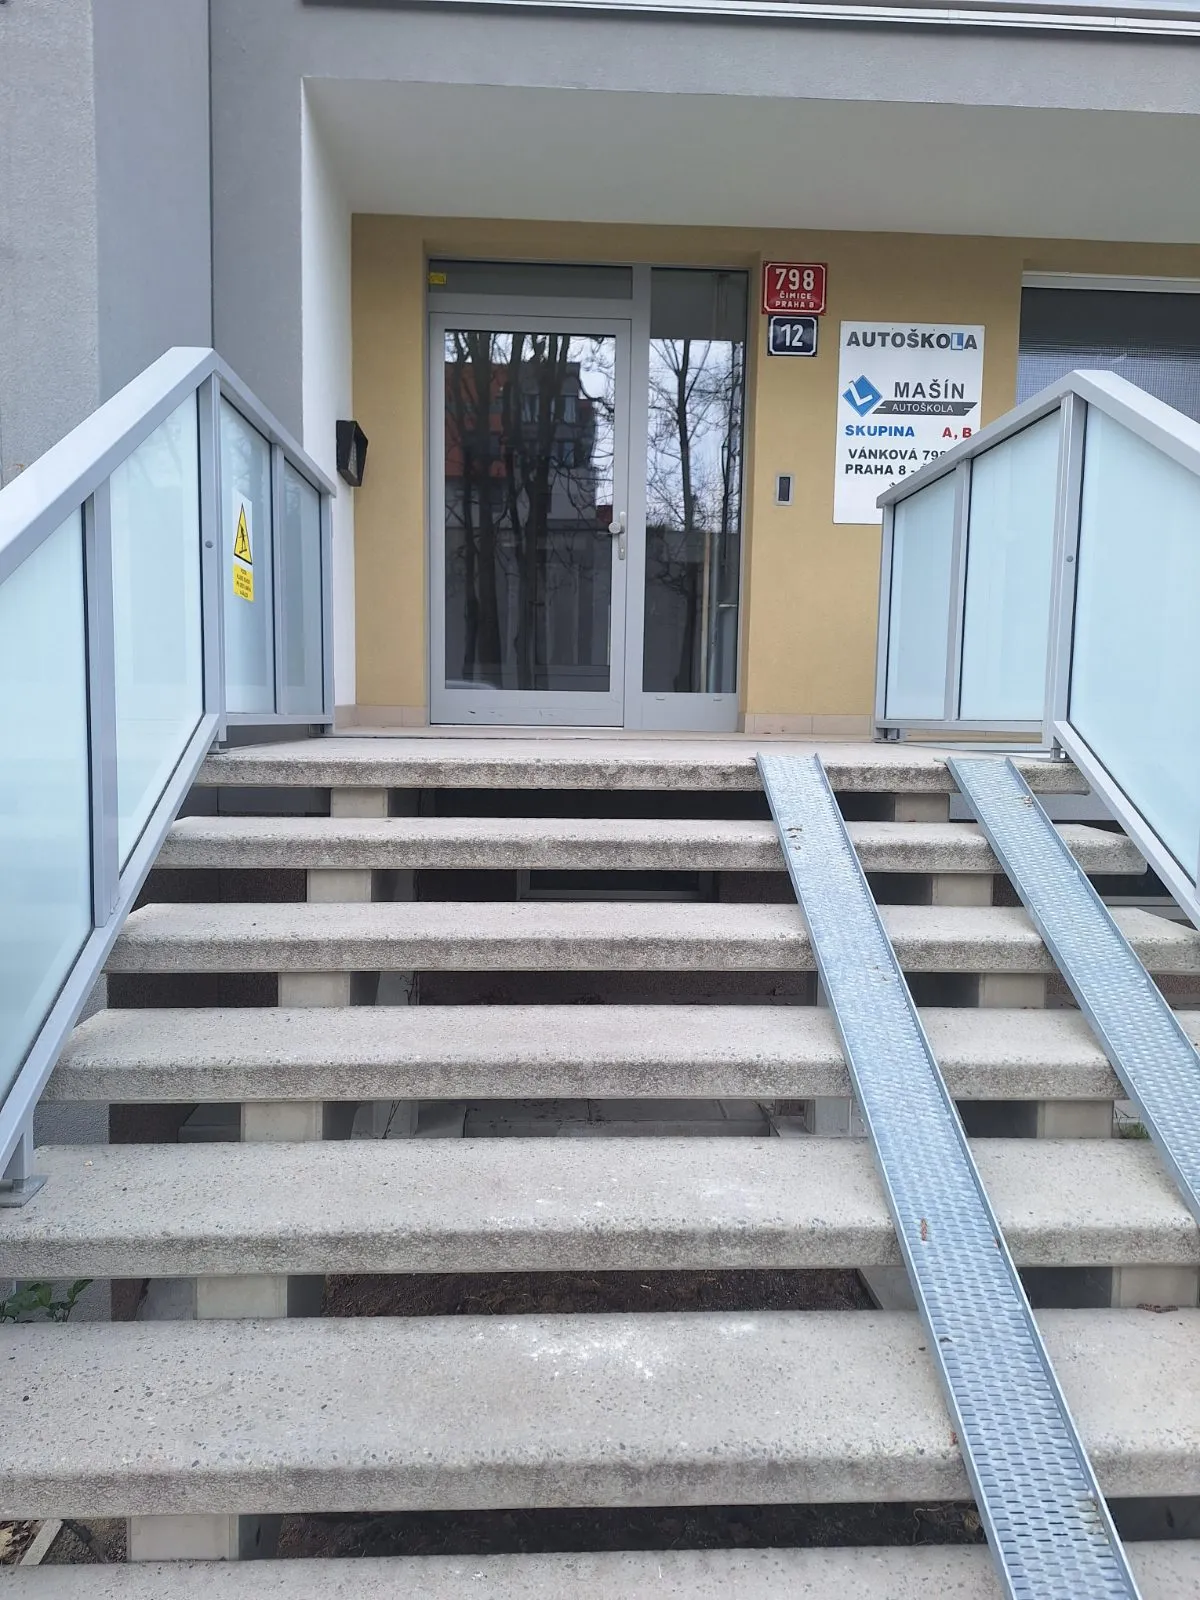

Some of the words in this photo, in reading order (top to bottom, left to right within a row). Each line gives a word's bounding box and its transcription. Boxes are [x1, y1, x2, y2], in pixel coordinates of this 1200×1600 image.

[775, 268, 815, 291] 798
[779, 290, 812, 300] ČIMICE
[775, 300, 806, 308] PRAHA
[780, 323, 804, 347] 12
[846, 328, 978, 351] AUTOŠKOLA
[894, 379, 965, 399] MAŠÍN
[891, 402, 954, 413] AUTOŠKOLA
[845, 424, 915, 438] SKUPINA
[848, 446, 918, 461] VÁNKOVÁ
[845, 464, 894, 475] PRAHA
[898, 464, 907, 476] 8
